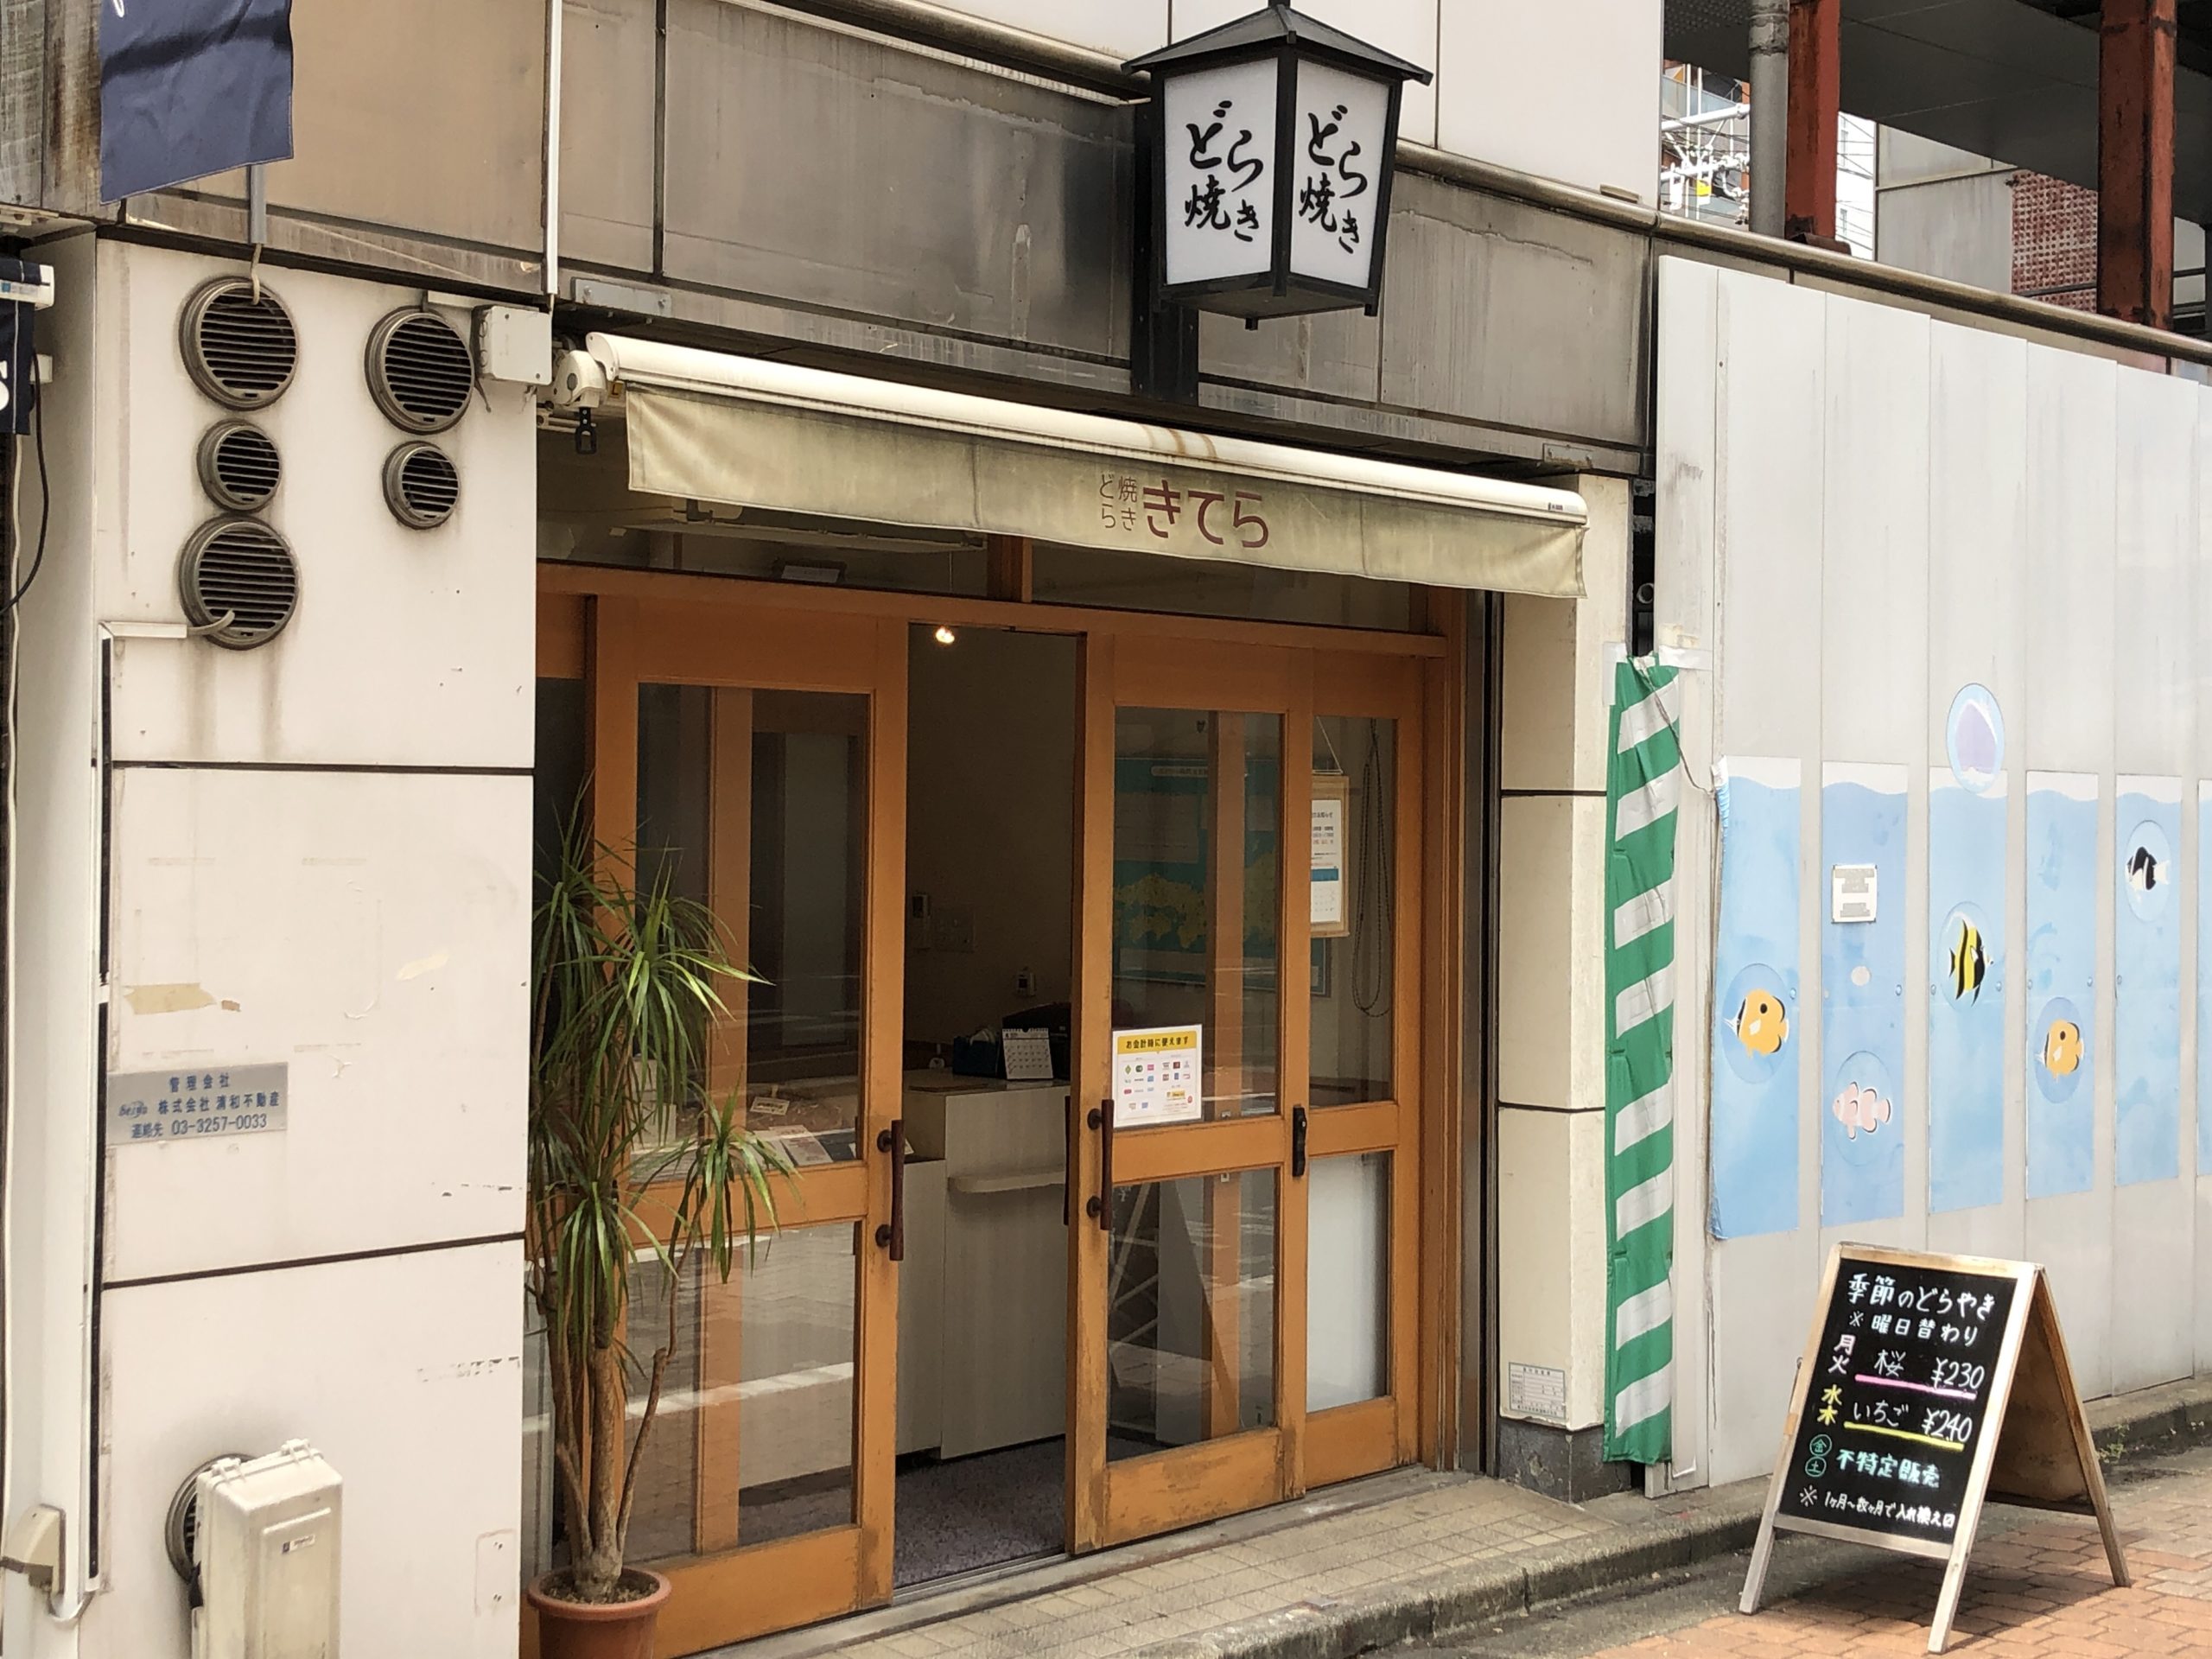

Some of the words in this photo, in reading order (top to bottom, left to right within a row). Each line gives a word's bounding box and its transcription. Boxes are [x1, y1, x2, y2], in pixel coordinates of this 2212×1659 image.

[1185, 100, 1264, 193] どら
[1307, 105, 1368, 199] どら
[1184, 175, 1259, 242] 焼き
[1298, 172, 1360, 254] 焼き
[1143, 479, 1269, 549] きてら
[1126, 1036, 1189, 1050] お会計時に使えます
[169, 1072, 230, 1093] 管理会社
[1848, 1273, 1996, 1322] 季節のどらやき
[1873, 1348, 1907, 1377] 桜
[1930, 1357, 1986, 1390] ¥230
[1853, 1399, 1910, 1427] いちご
[1921, 1407, 1974, 1443] ¥240
[1835, 1448, 1940, 1489] 不特定販売
